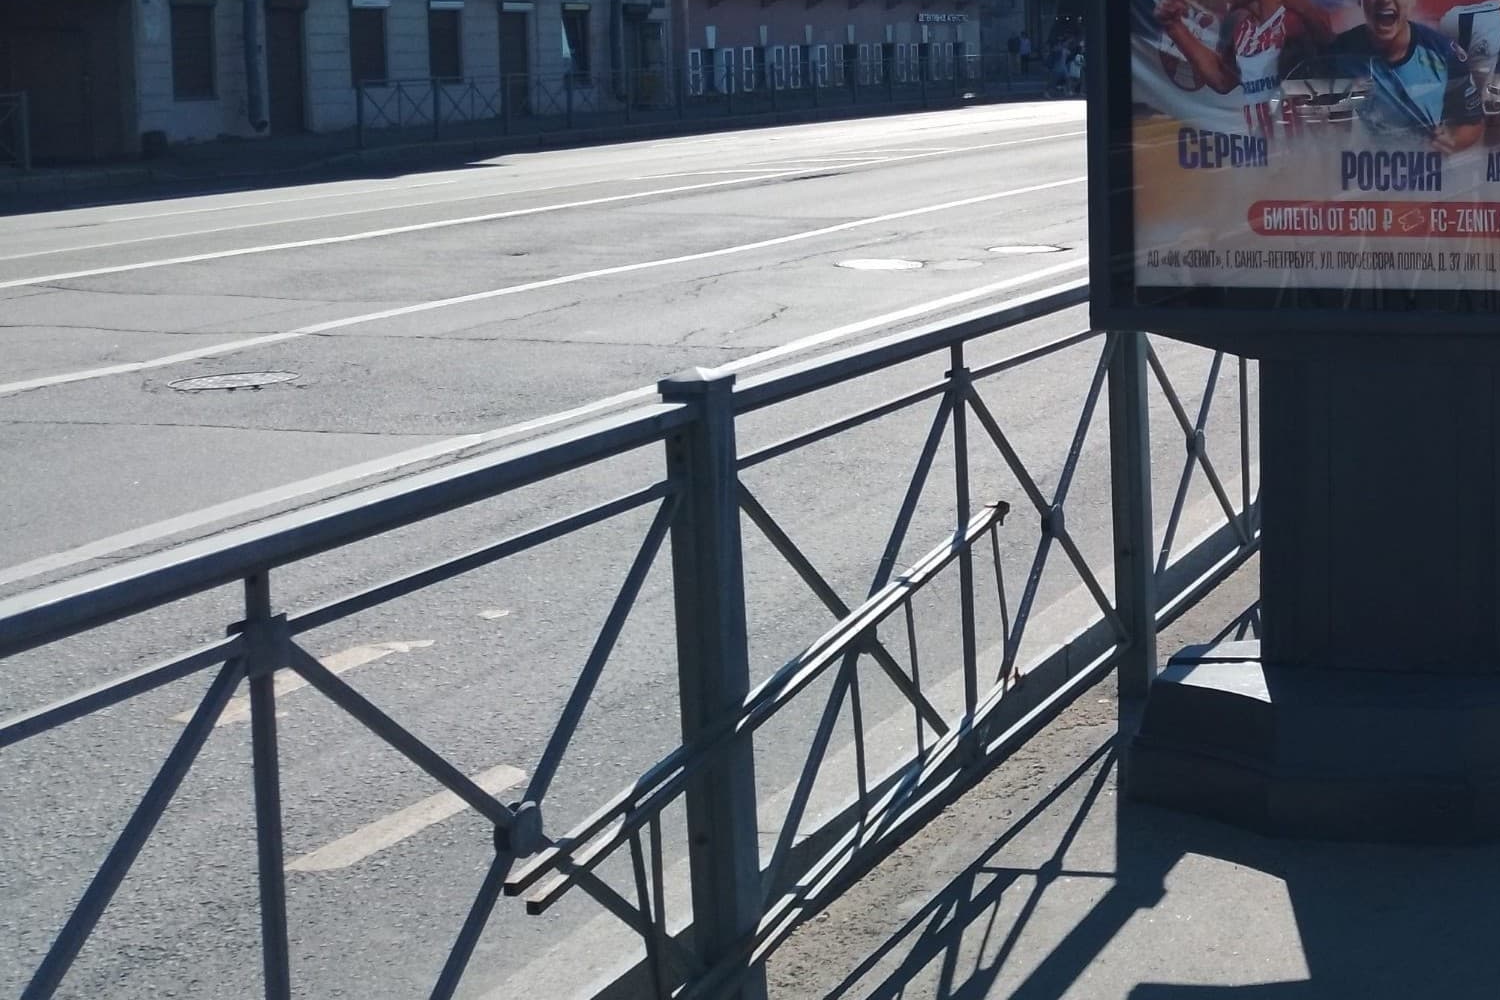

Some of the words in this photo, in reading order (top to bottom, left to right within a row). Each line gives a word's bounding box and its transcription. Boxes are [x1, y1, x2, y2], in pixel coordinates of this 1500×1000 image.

[1178, 127, 1268, 169] СЕРБИЯ
[1341, 151, 1442, 191] РОССИЯ
[1263, 207, 1323, 231] БИЛЕТЫ
[1327, 208, 1345, 231] ОТ
[1349, 208, 1377, 231] 500
[1146, 250, 1159, 268] АО
